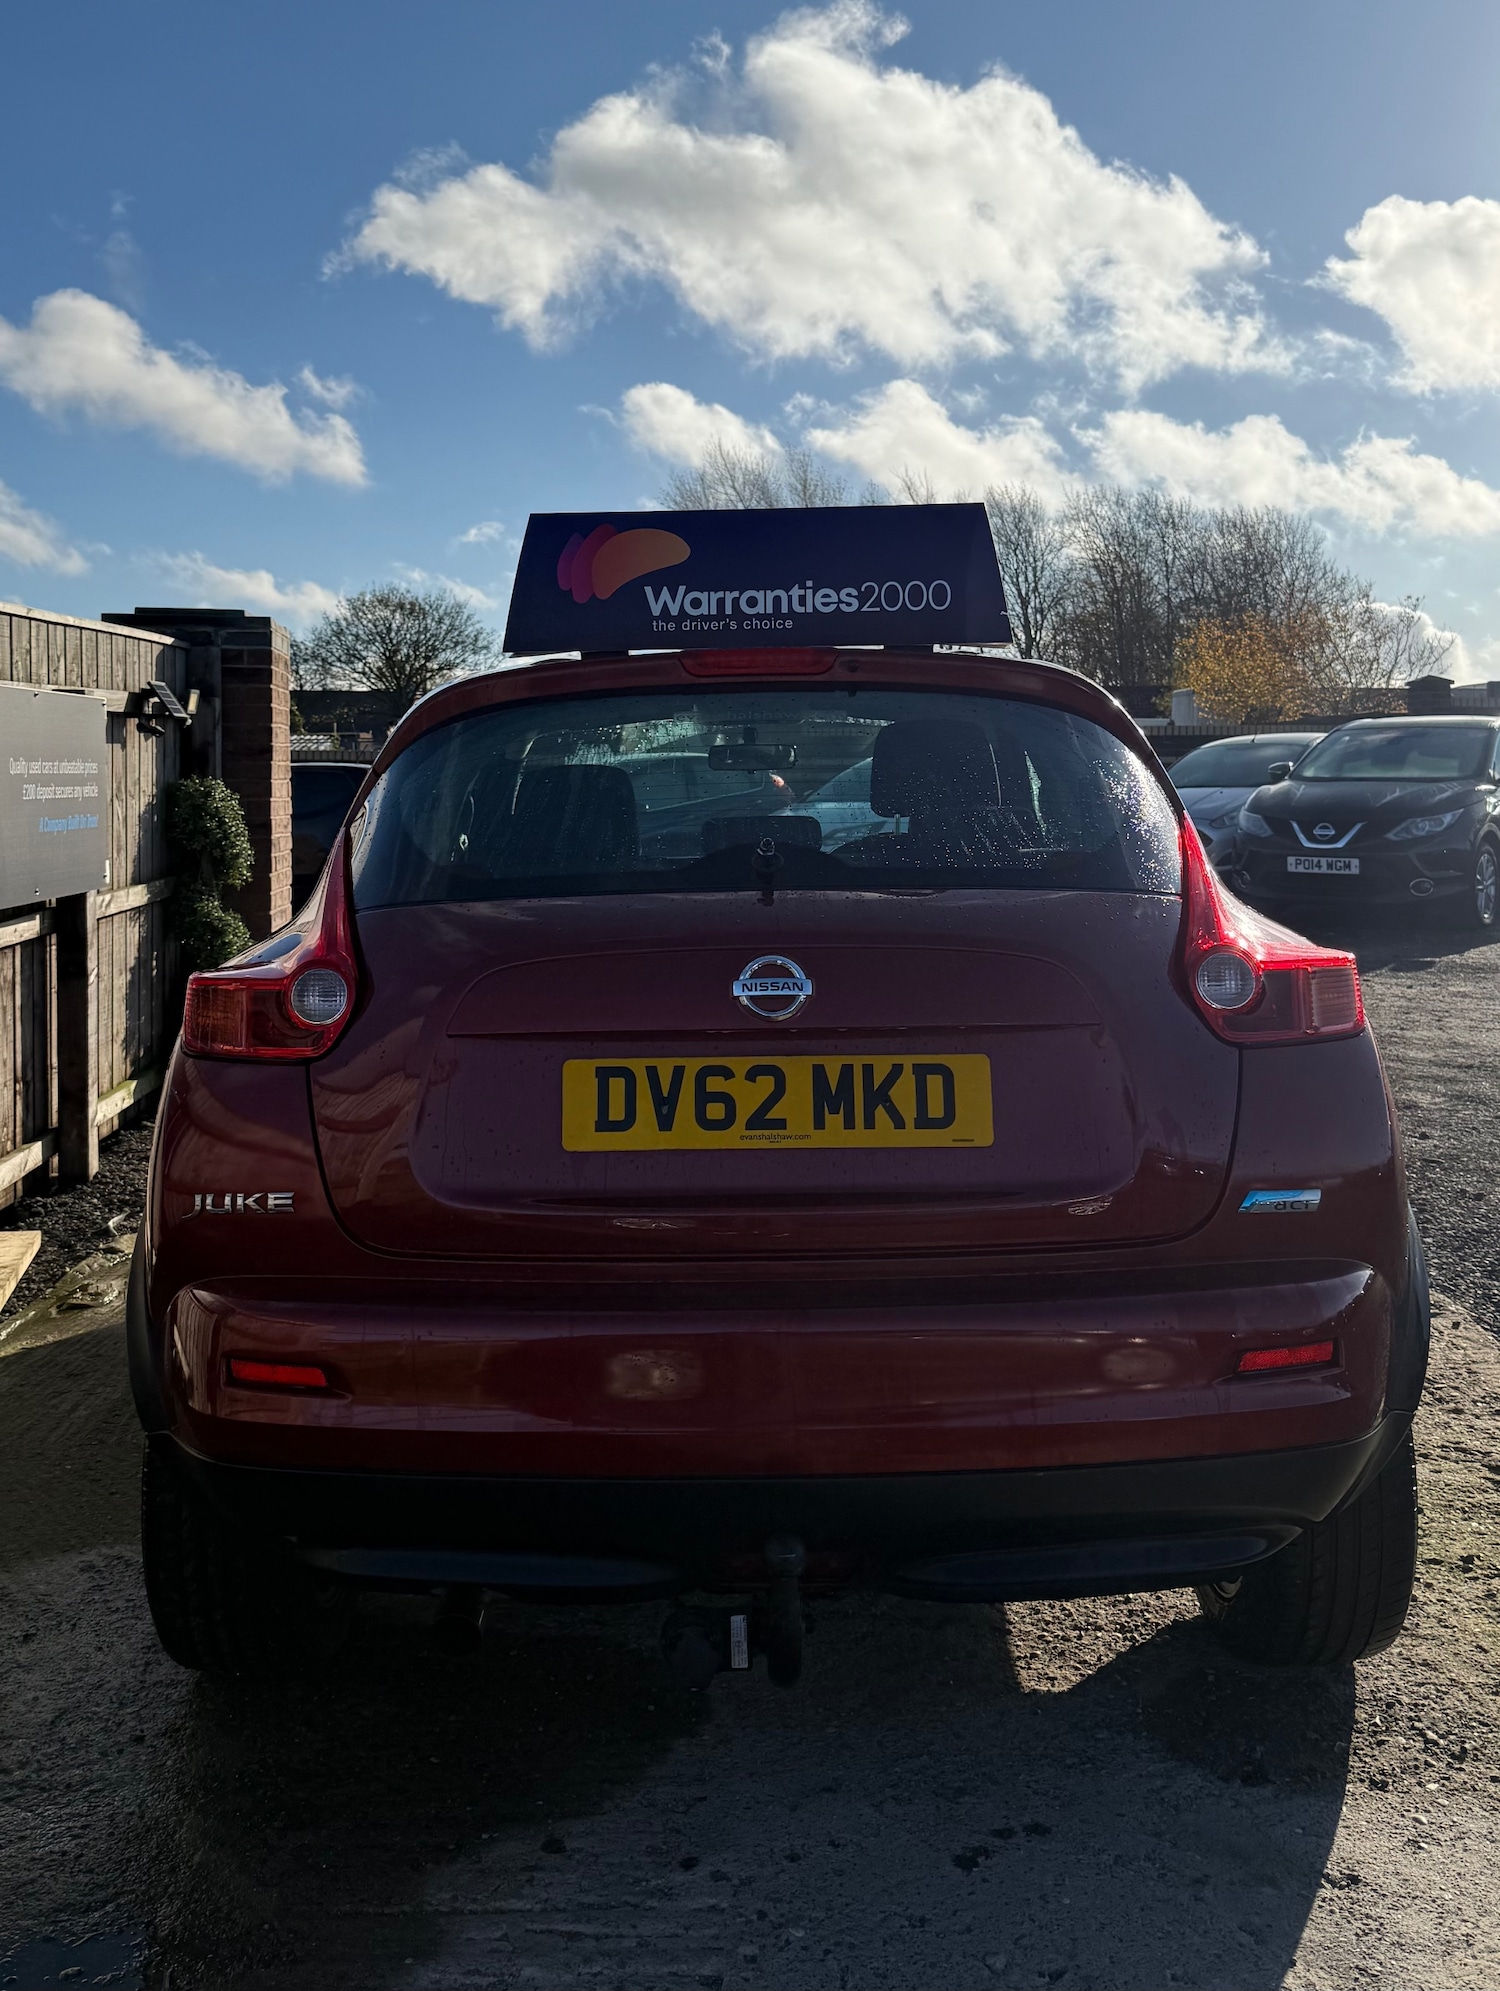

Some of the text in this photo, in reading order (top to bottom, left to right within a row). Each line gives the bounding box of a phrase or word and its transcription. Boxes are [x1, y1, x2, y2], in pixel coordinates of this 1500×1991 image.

[644, 579, 952, 617] Warranties2000
[652, 617, 793, 631] the driver's choice
[9, 757, 98, 778] Quality used cars at unbeatable prices
[22, 782, 98, 803] £200 deposit secures any vehicle
[1326, 859, 1351, 872] WGM
[741, 981, 804, 993] NISSAN
[594, 1062, 956, 1133] DV62 MKD
[740, 1132, 812, 1141] evanshalshaw.com
[181, 1192, 295, 1218] JUKE
